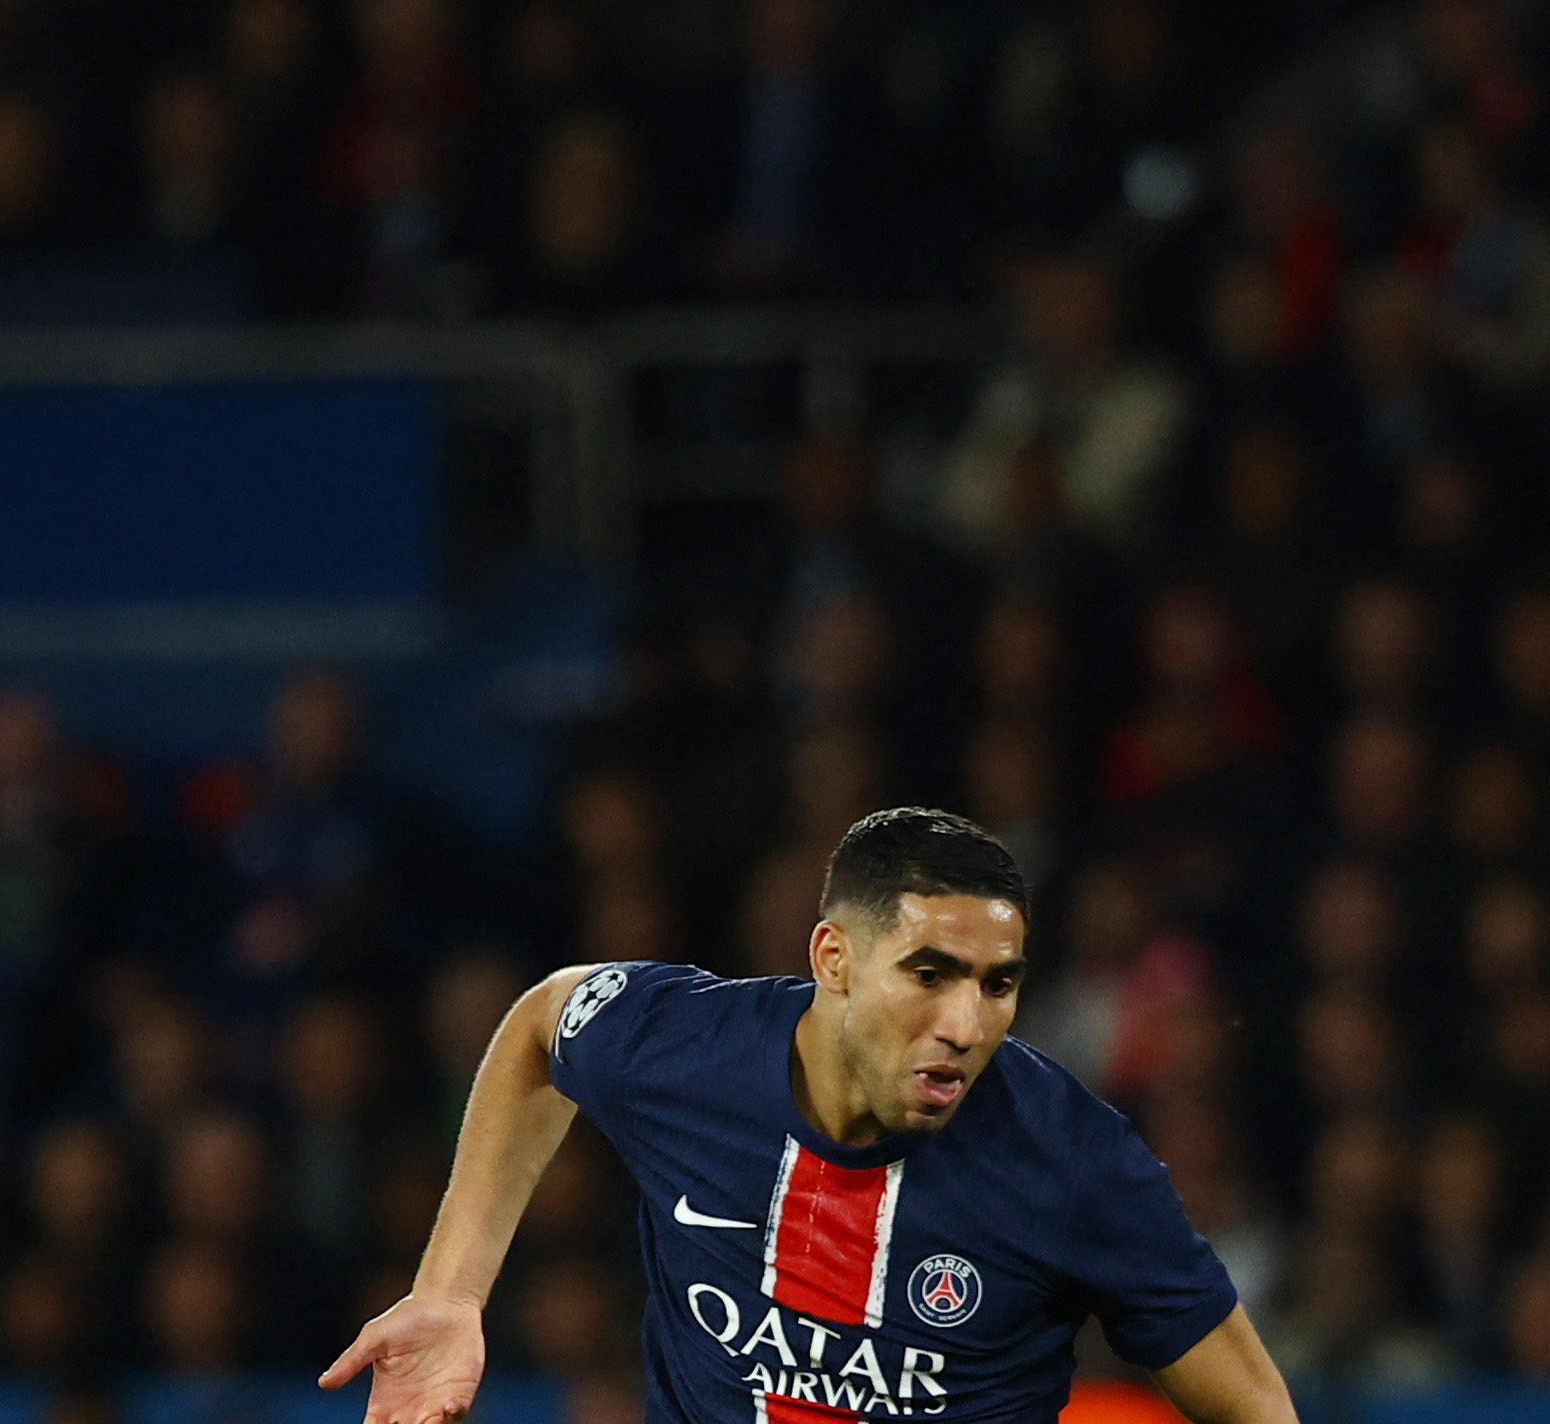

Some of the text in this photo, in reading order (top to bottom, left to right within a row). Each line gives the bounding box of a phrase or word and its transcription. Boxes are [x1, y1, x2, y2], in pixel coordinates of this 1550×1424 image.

[923, 1258, 972, 1279] PARIS
[687, 1283, 948, 1398] QATAR
[741, 1362, 947, 1416] AIRWAS
